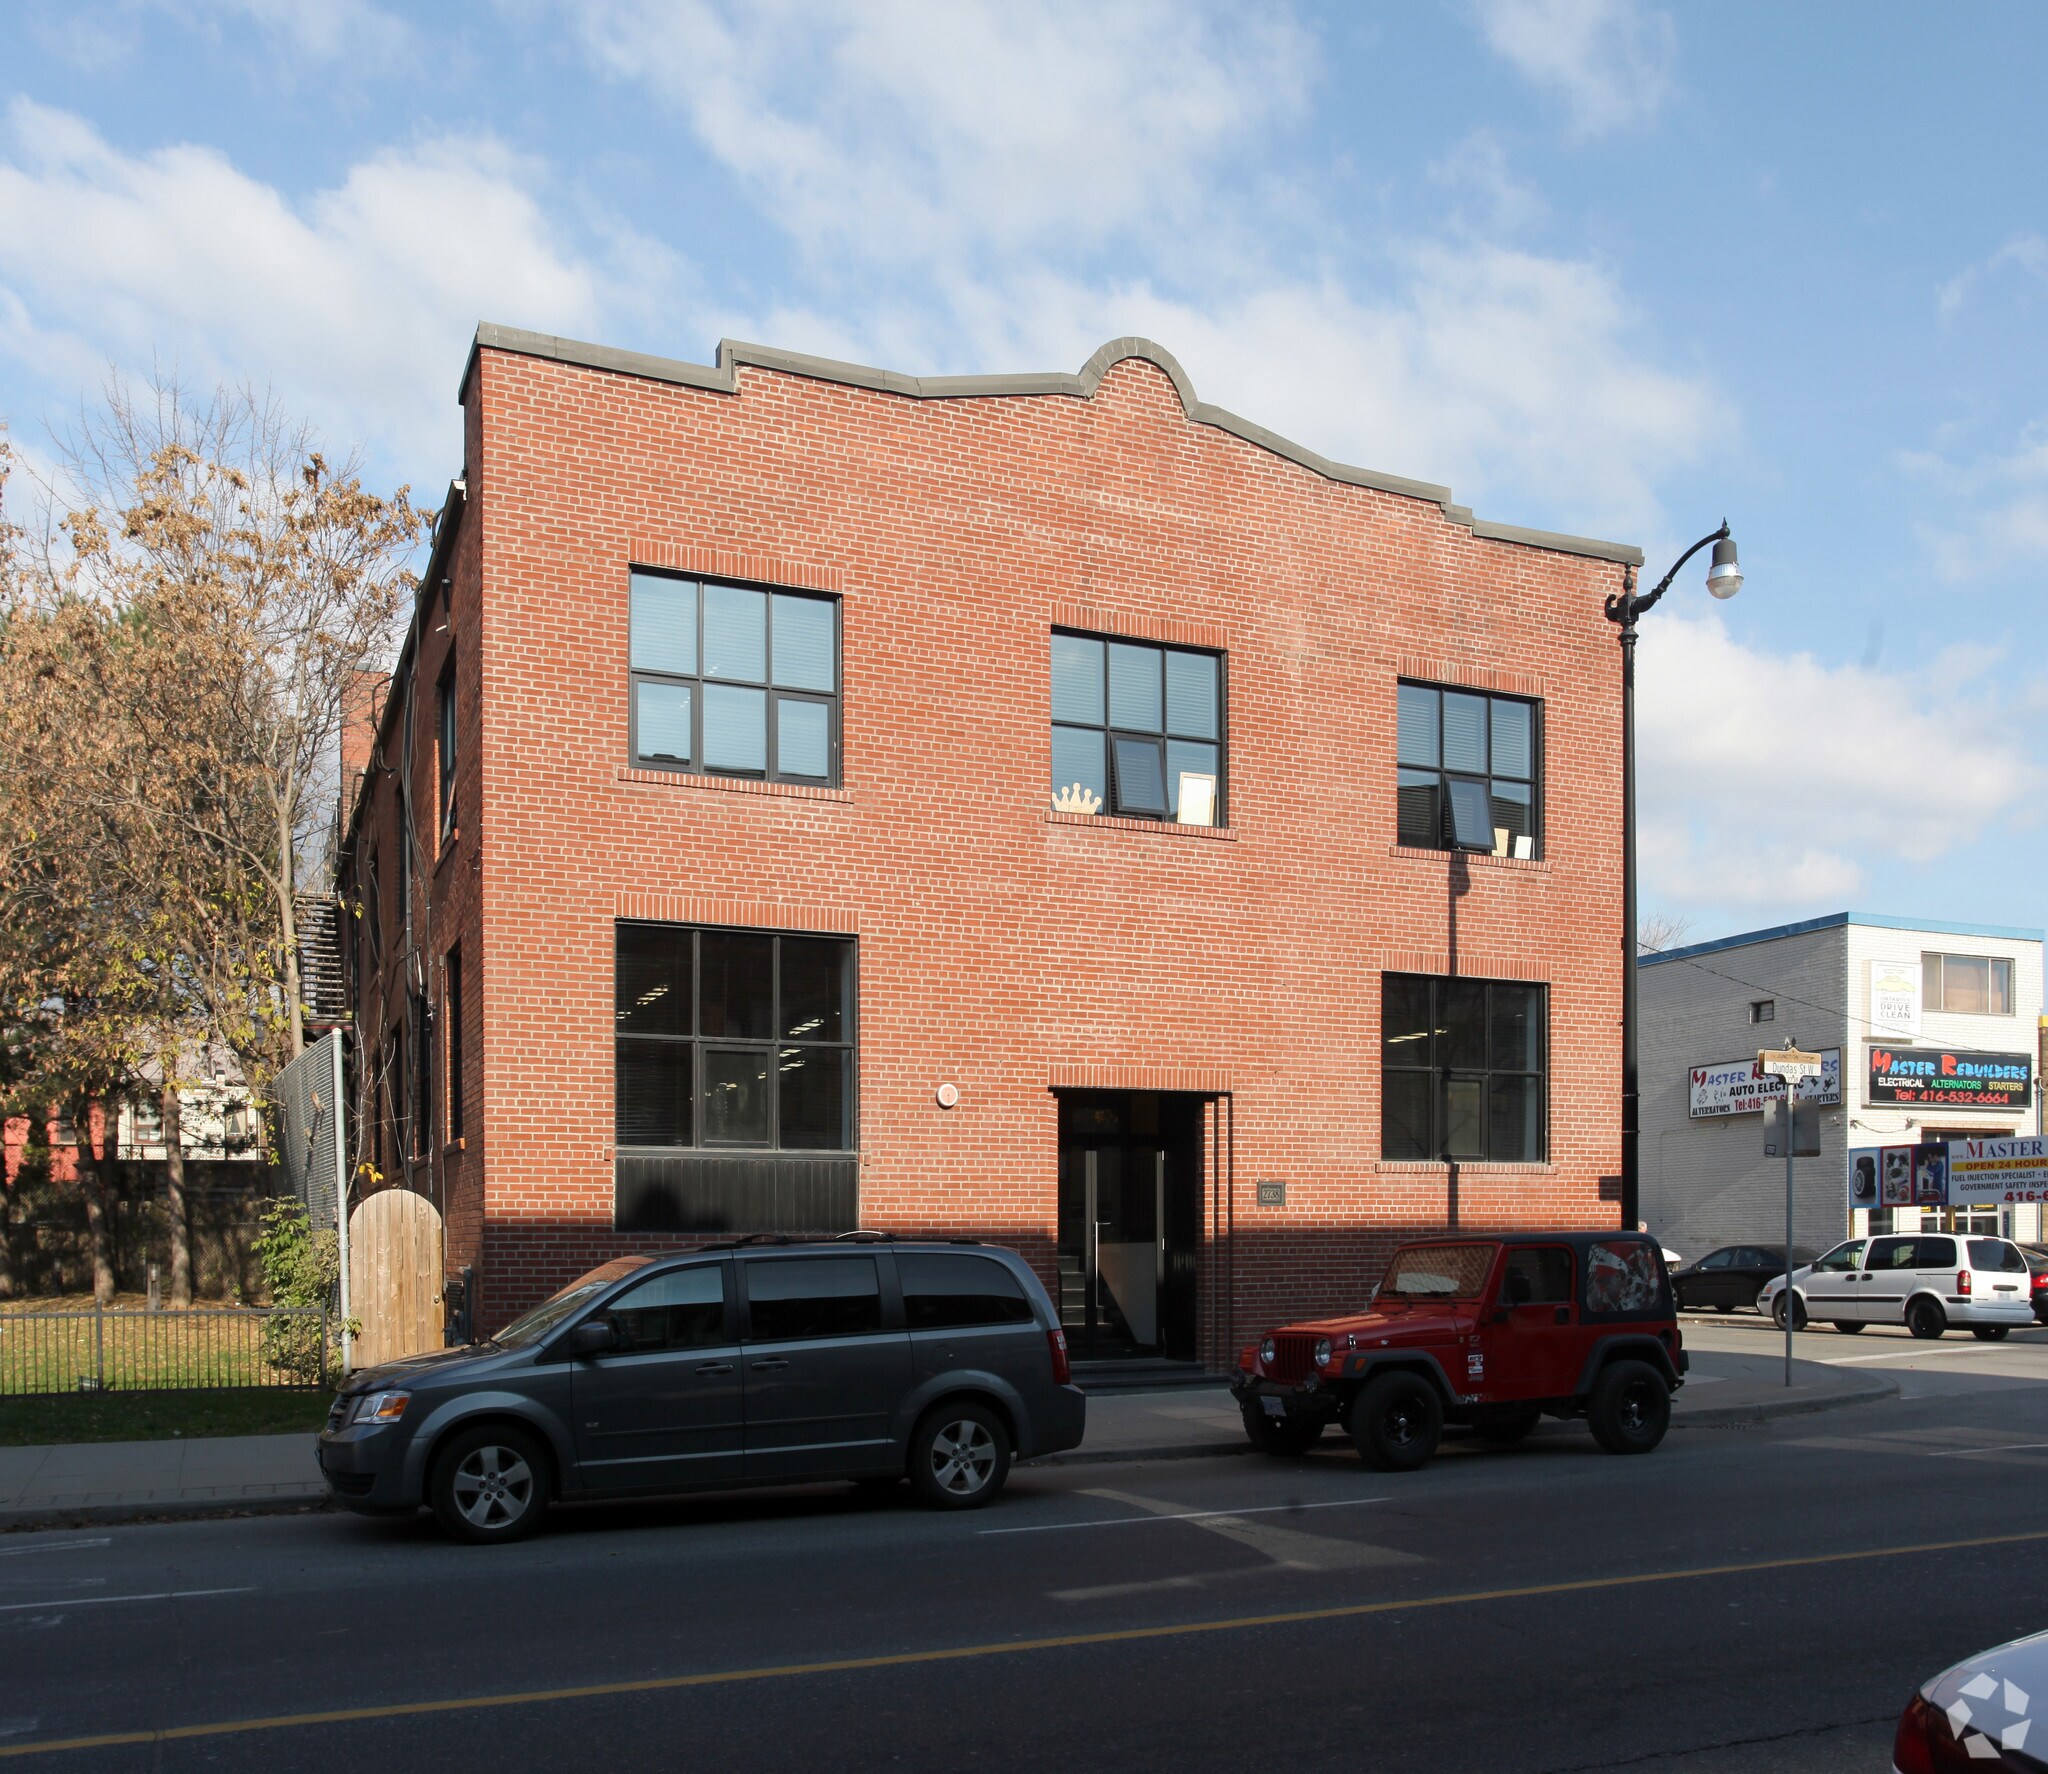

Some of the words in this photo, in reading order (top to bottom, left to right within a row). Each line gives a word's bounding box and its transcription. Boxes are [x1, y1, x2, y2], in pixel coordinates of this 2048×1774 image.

[1880, 1003, 1910, 1011] DRIVE
[1880, 1011, 1910, 1019] CLEAN
[1773, 1062, 1797, 1074] Dundas
[1800, 1063, 1806, 1074] St
[1808, 1064, 1814, 1074] W
[1872, 1049, 1935, 1076] MASTER
[1941, 1054, 2028, 1080] REBUILDERS
[1692, 1069, 1746, 1088] MASTER
[1878, 1077, 1924, 1088] ELECTRICAL
[1931, 1079, 1982, 1089] ALTERNATORS
[1988, 1081, 2024, 1091] STARTERS
[1729, 1085, 1754, 1097] AUTO
[1758, 1078, 1804, 1094] ELECTIC
[1894, 1089, 1915, 1101] Tel:
[1920, 1090, 2009, 1104] 416-532-6664
[1692, 1104, 1731, 1116] ALTERNATORS
[1966, 1141, 2043, 1159] MASTER
[1965, 1162, 1995, 1171] OPEN
[2015, 1158, 2048, 1168] HOUR
[1951, 1174, 1965, 1182] FUEL
[1967, 1172, 1999, 1181] INJECTION
[2001, 1171, 2035, 1180] SPECIALIST
[1960, 1182, 2003, 1191] GOVERNMENT
[2005, 1181, 2027, 1189] SAFETY
[2028, 1181, 2048, 1189] INSPE
[1262, 1189, 1280, 1199] 2738
